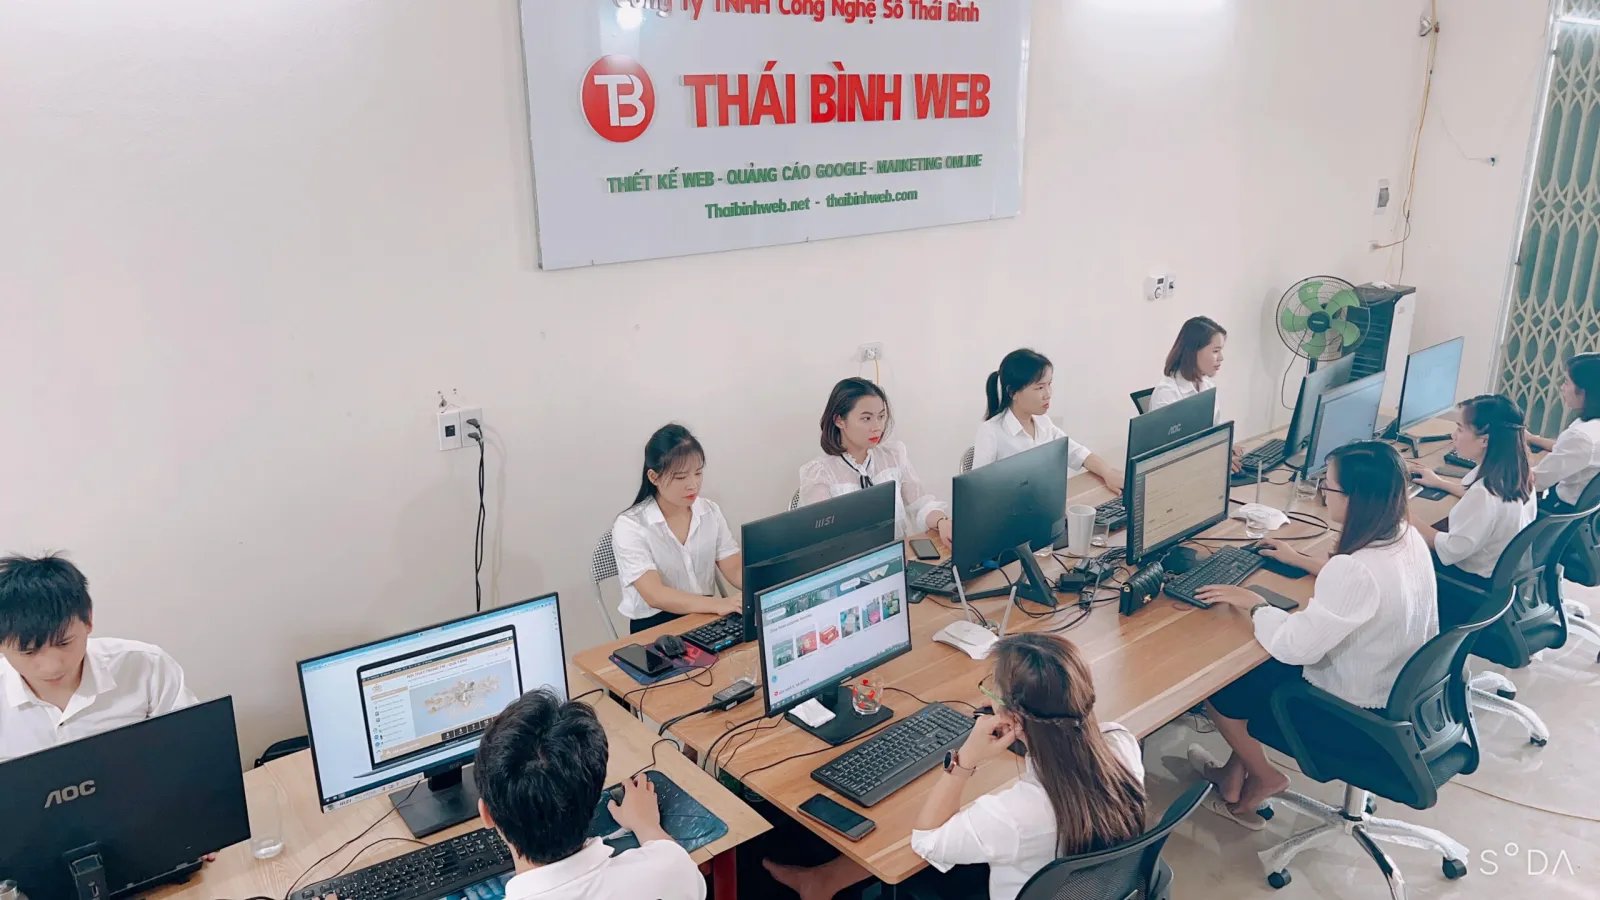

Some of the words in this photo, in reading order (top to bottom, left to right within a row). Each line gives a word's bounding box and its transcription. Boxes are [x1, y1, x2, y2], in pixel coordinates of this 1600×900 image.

[908, 0, 942, 20] Thái
[946, 0, 980, 22] Bình
[683, 61, 796, 128] THÁI
[809, 61, 902, 123] BÌNH
[913, 73, 991, 120] WEB
[607, 169, 652, 193] THIẾT
[657, 167, 679, 190] KẾ
[682, 171, 715, 188] WEB
[726, 162, 777, 185] QUẢNG
[782, 161, 811, 180] CÁO
[815, 162, 867, 179] GOOGLE
[876, 157, 943, 174] MARKETING
[945, 154, 984, 169] ONLINE
[704, 198, 810, 219] Thaibinhweb.net
[825, 189, 917, 208] thaibinhweb.com
[44, 780, 96, 808] AOC
